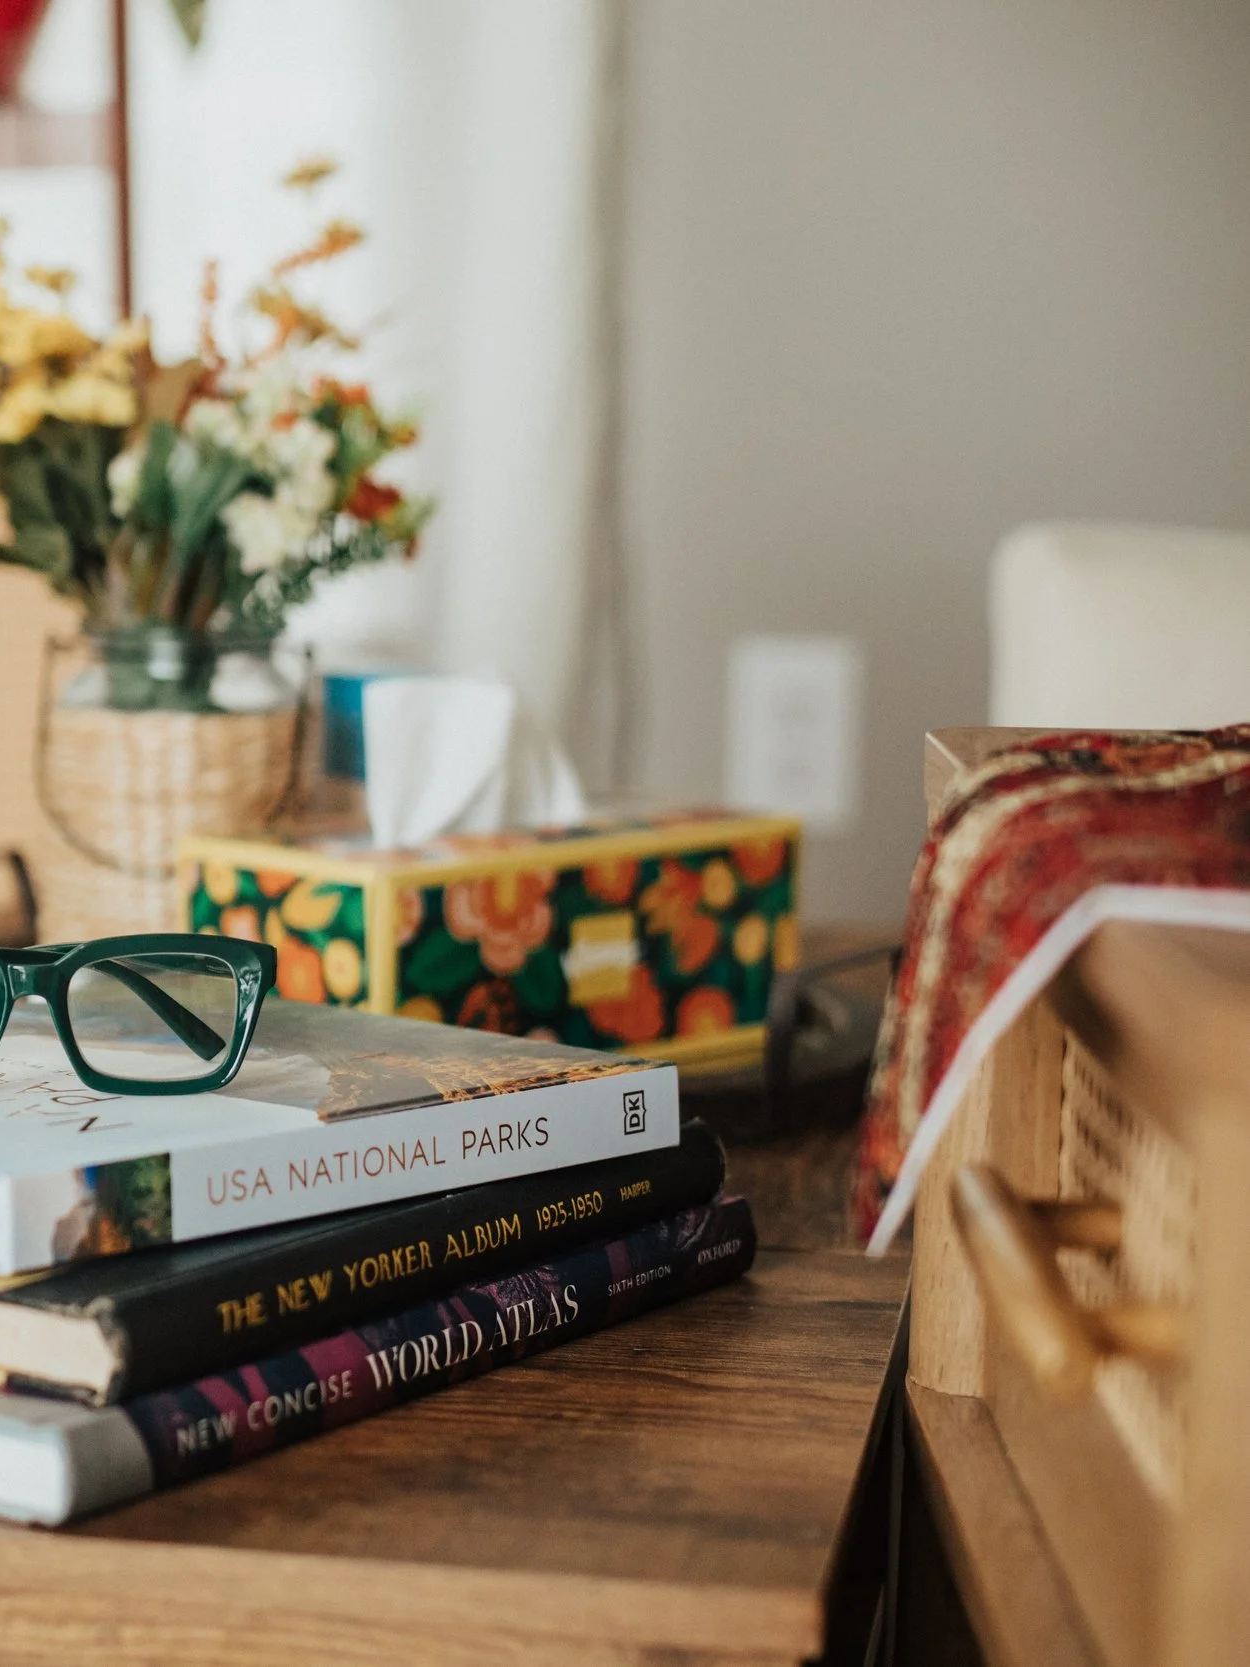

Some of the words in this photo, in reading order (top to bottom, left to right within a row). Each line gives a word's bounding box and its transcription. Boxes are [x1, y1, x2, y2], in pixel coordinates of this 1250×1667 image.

[628, 1096, 640, 1128] DK
[207, 1167, 273, 1206] USA
[288, 1136, 446, 1191] NATIONAL
[462, 1117, 549, 1160] PARKS
[216, 1291, 269, 1334] THE
[276, 1268, 332, 1314] NEW
[343, 1239, 433, 1292] YORKER
[444, 1213, 521, 1262] ALBUM
[535, 1190, 603, 1231] 1925-1950
[620, 1180, 652, 1202] HARPER
[607, 1278, 633, 1297] SIXTH
[635, 1264, 672, 1288] EDITION
[697, 1238, 741, 1265] OXFORD
[176, 1411, 235, 1456] NEW
[246, 1370, 352, 1430] CONCISE
[364, 1319, 483, 1392] WORLD
[488, 1284, 579, 1352] ATLAS
